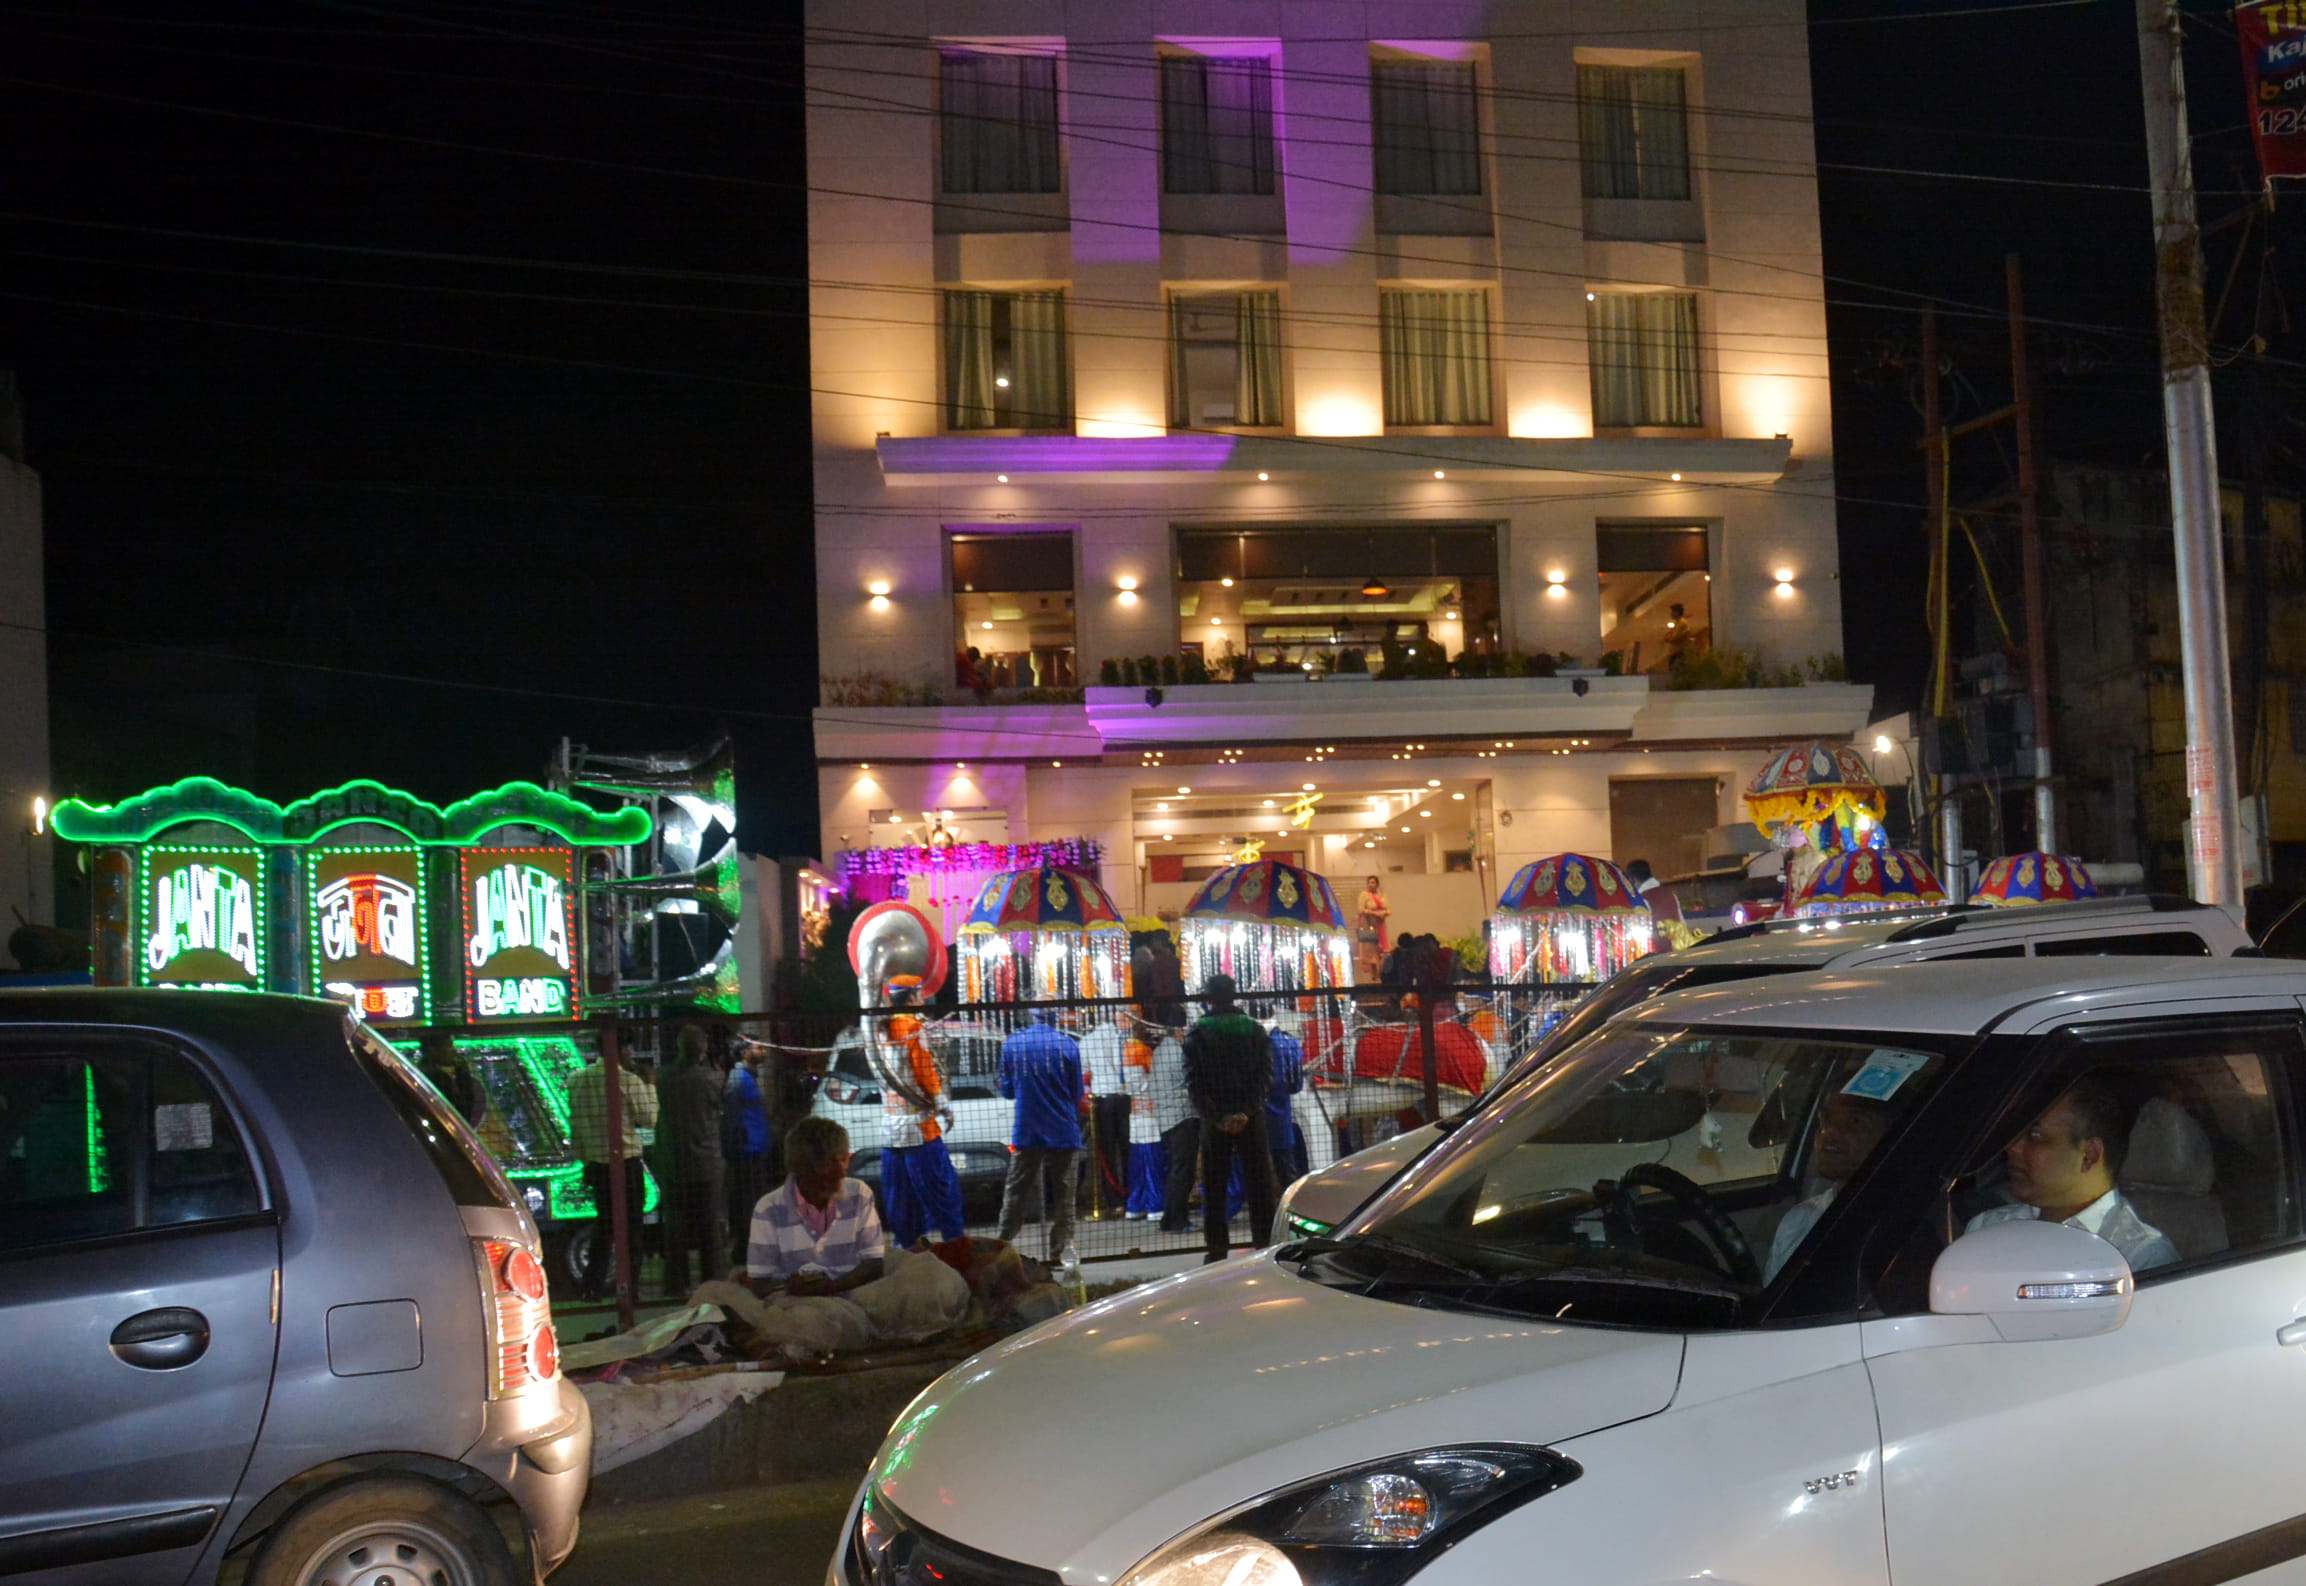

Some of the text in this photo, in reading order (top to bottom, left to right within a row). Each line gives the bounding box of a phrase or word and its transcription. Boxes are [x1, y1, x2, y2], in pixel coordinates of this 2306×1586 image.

[149, 864, 258, 976] JANTA
[317, 873, 416, 966] जनता
[469, 863, 571, 970] JANTA
[477, 977, 565, 1016] BAND
